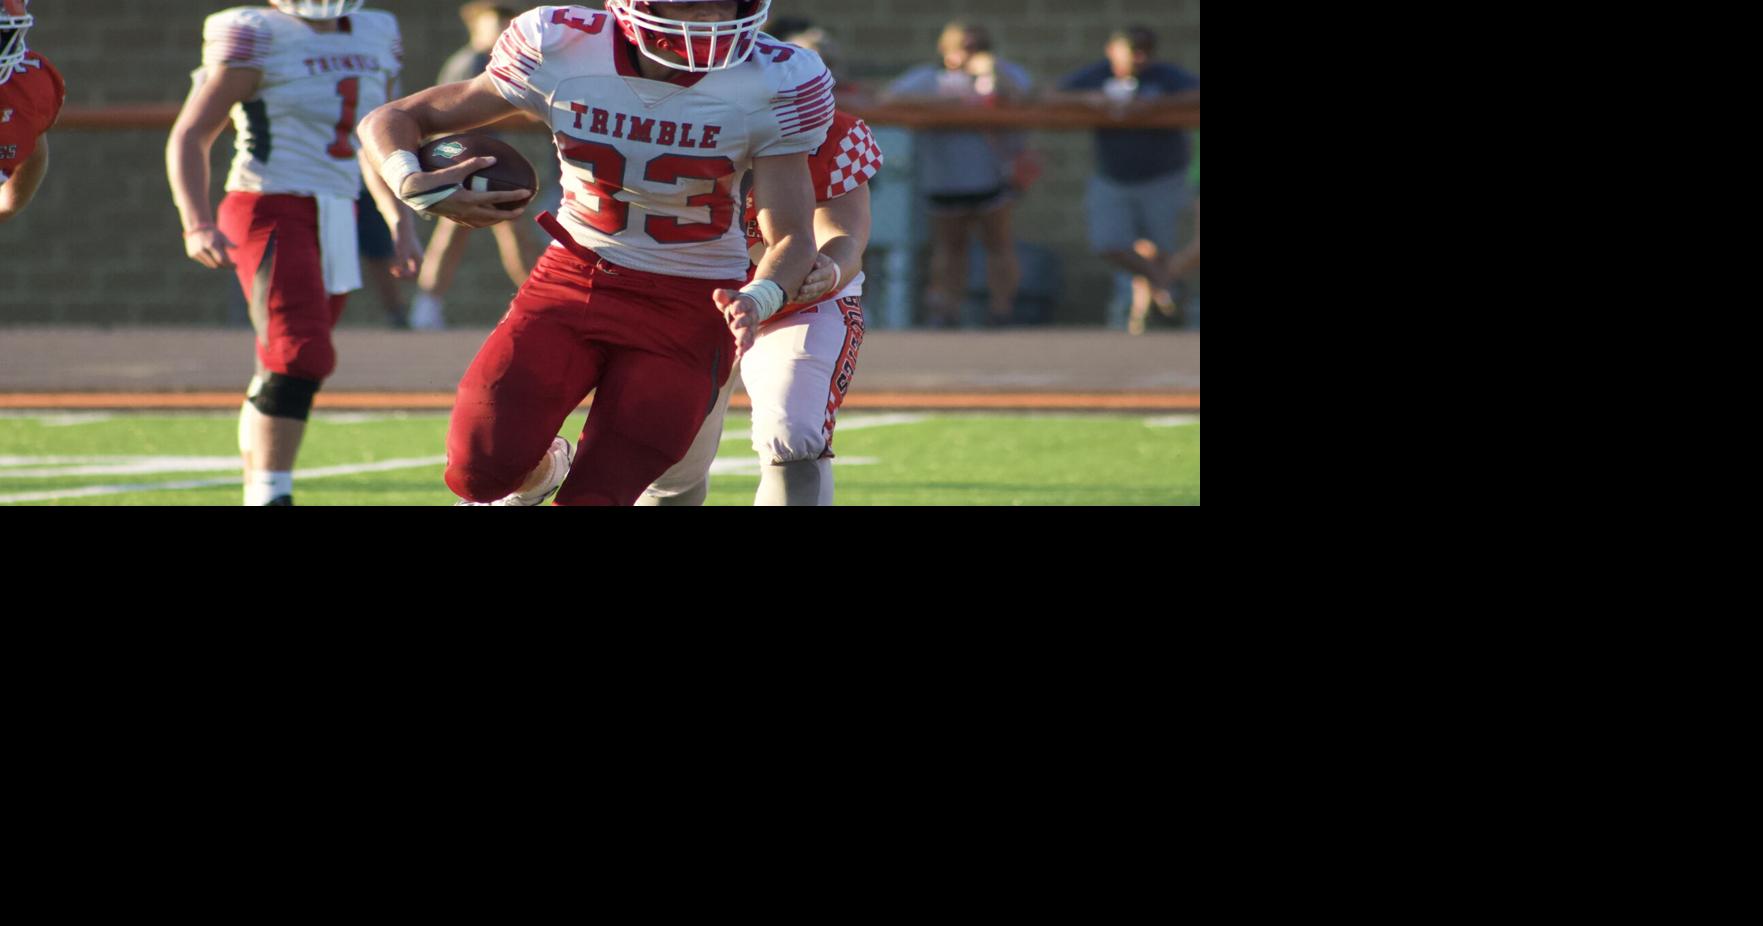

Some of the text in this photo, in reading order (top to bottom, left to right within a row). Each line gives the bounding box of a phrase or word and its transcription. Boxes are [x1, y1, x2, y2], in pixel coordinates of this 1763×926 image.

[552, 8, 607, 34] 3
[326, 75, 360, 161] 1
[571, 102, 721, 149] TRIMBLE
[557, 131, 736, 244] 33
